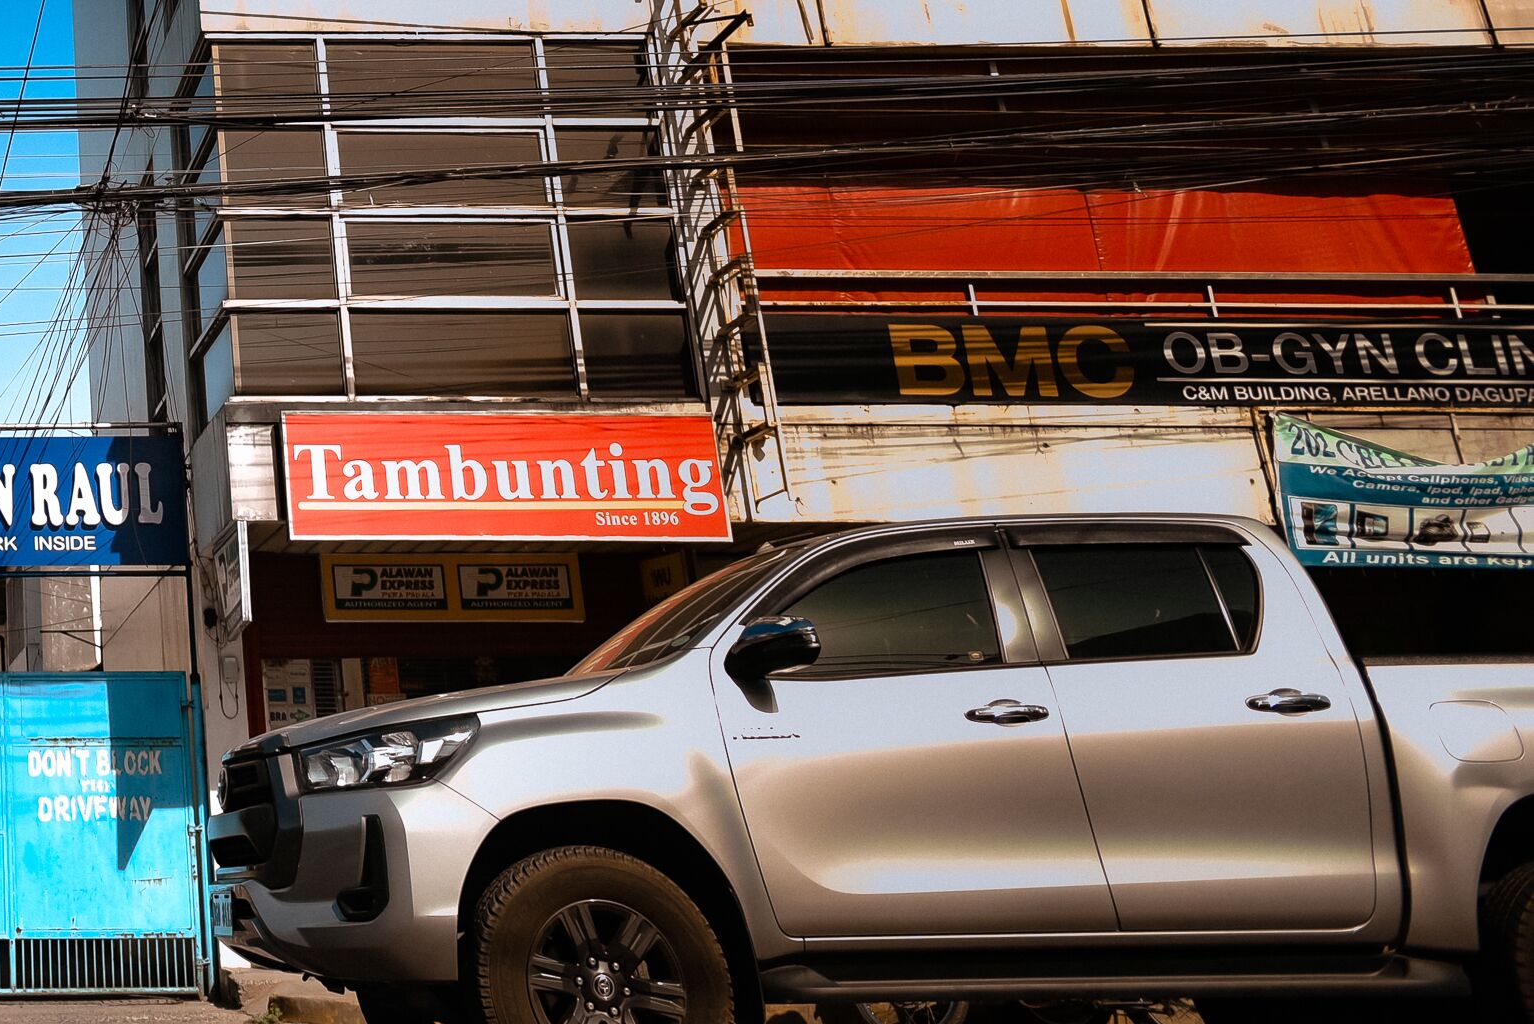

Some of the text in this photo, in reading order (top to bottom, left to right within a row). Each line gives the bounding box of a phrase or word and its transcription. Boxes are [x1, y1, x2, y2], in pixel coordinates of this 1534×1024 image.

[1163, 331, 1399, 375] OB-GYN
[888, 324, 1135, 398] BMC
[1182, 385, 1229, 401] C&M
[1235, 385, 1337, 404] BUILDING,
[1342, 386, 1450, 403] ARELLANO
[293, 442, 720, 516] Tambunting
[1309, 465, 1337, 475] We
[1342, 468, 1404, 481] Accept
[1352, 479, 1420, 493] Camera,
[29, 461, 164, 530] RAUL
[1421, 496, 1451, 504] and
[1454, 496, 1492, 505] other
[595, 511, 680, 526] Since 1896
[34, 535, 97, 551] INSIDE
[1322, 551, 1356, 564] All
[1366, 552, 1429, 565] units
[1439, 556, 1478, 565] are
[380, 579, 435, 590] EXPRESS
[506, 579, 560, 590] EXPRESS
[344, 600, 438, 608] AUTHORIZED AGENT
[470, 600, 564, 608] AUTHORIZED AGENT
[27, 747, 163, 777] DON'T BLOCK
